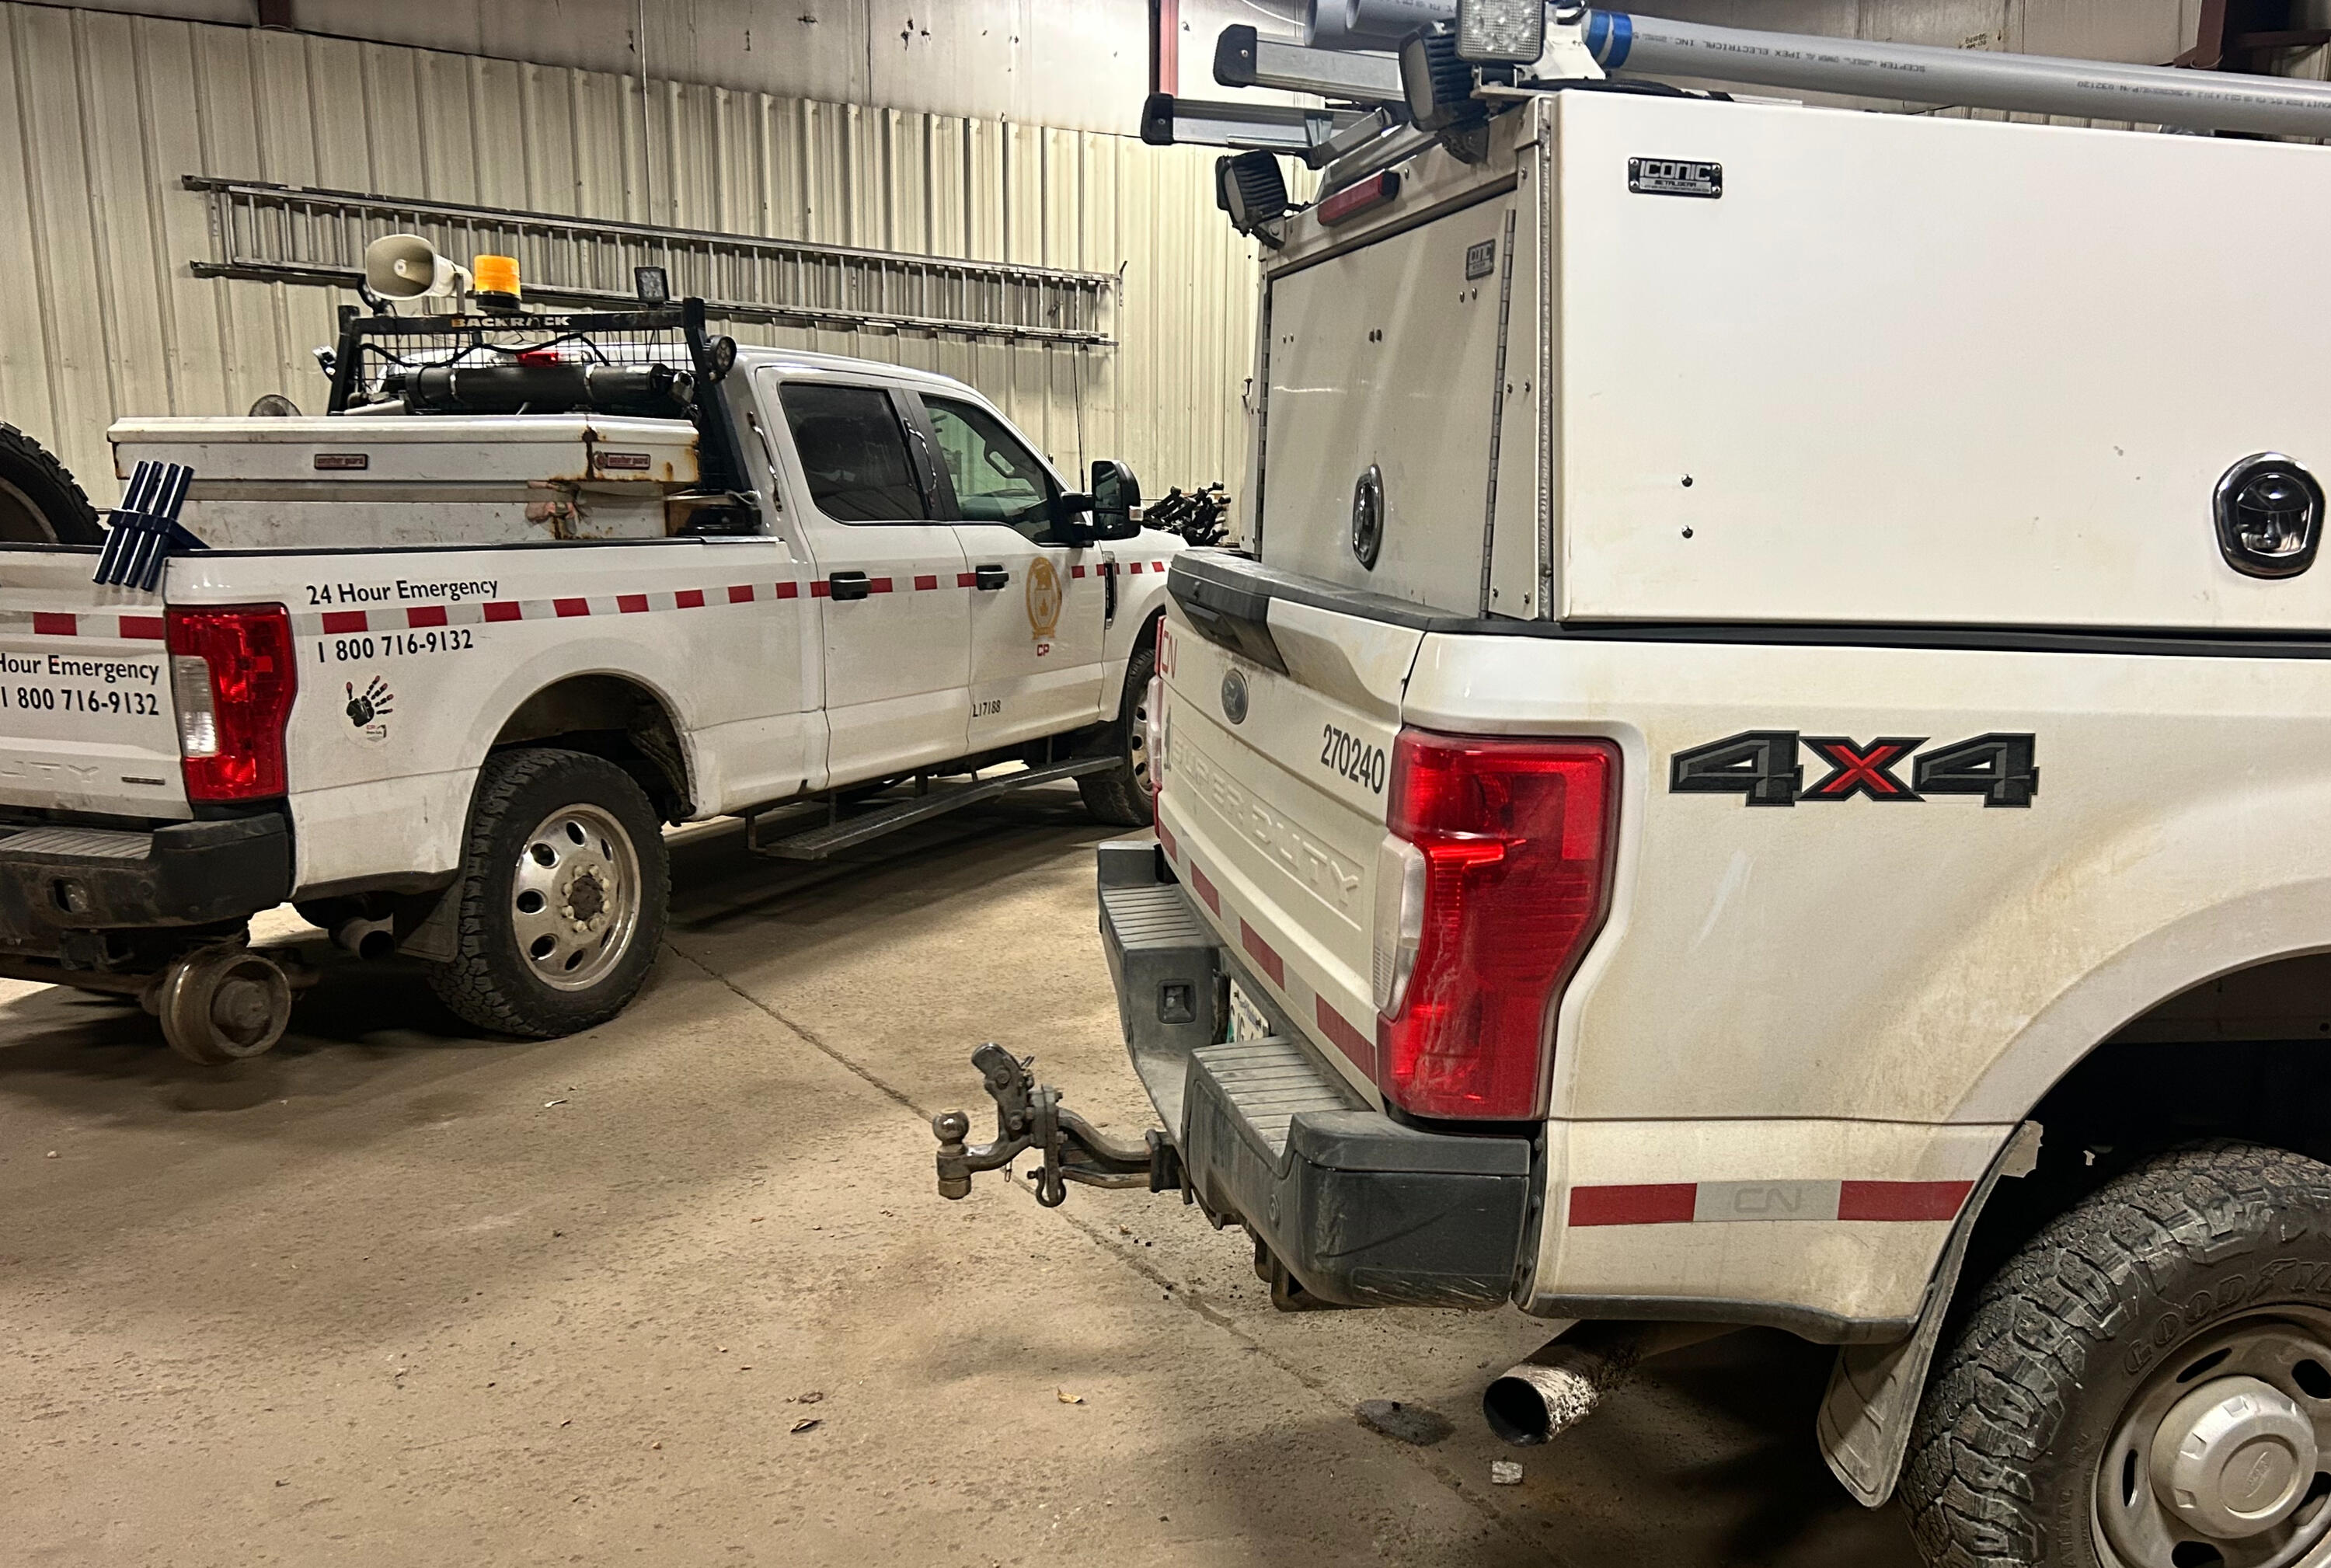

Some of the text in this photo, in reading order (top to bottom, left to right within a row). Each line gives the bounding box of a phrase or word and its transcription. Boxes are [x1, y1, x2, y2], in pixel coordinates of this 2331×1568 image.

[1702, 40, 1769, 56] ELECTRICAL
[1775, 50, 1801, 60] IPEX
[1880, 61, 1925, 72] SCEPTER
[1639, 160, 1711, 181] ICONIC
[306, 580, 498, 605] 24 Hour Emergency
[318, 629, 474, 663] 1 800 716-9132
[1037, 643, 1050, 657] CP
[1162, 630, 1178, 679] CN
[47, 654, 159, 685] Emergency
[2, 686, 159, 716] 1 800 716-9132
[972, 699, 1001, 717] L17188
[1321, 723, 1385, 794] 270240
[1252, 803, 1359, 908] DUTY
[1733, 1187, 1802, 1213] CN
